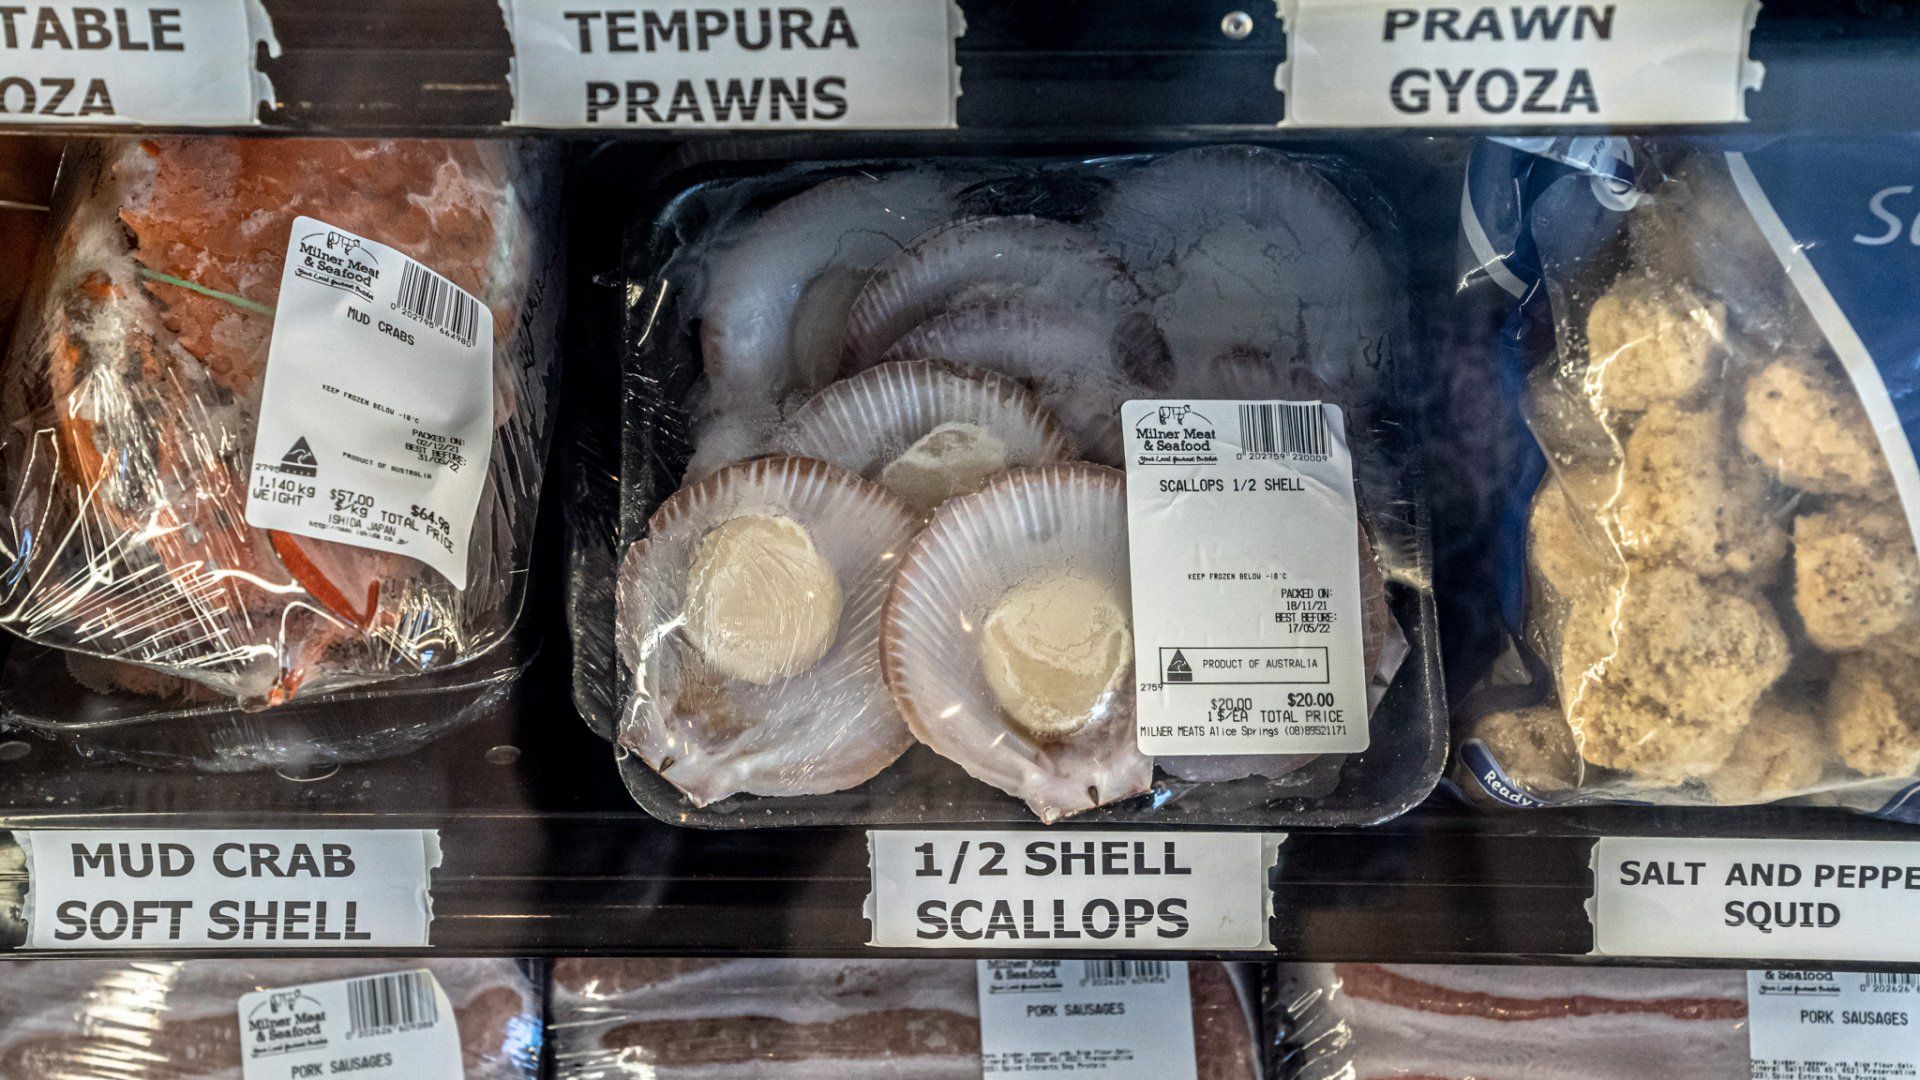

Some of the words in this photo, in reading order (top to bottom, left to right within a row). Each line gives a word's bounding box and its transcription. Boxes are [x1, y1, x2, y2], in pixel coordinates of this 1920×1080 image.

[0, 6, 185, 51] TABLE
[563, 7, 859, 54] TEMPURA
[1382, 4, 1616, 41] PRAWN
[585, 76, 849, 123] PRAWNS
[1389, 68, 1600, 114] GYOZA
[299, 242, 345, 266] Milner
[347, 259, 379, 279] Meat
[304, 256, 314, 268] &
[317, 260, 372, 287] Seafood
[347, 306, 371, 326] MUD
[378, 320, 415, 346] CRABS
[322, 384, 340, 394] KEEP
[343, 392, 369, 406] FROZEN
[373, 403, 395, 415] BELOW
[412, 428, 445, 443] PACKED
[1136, 428, 1180, 439] Milner
[1183, 428, 1216, 439] Meat
[405, 442, 427, 454] BEST
[432, 450, 467, 466] BEFORE:
[416, 438, 459, 453] 02/12/21
[1144, 440, 1154, 451] &
[1156, 440, 1211, 451] Seafood
[343, 452, 374, 465] PRODUCT
[378, 461, 387, 469] OF
[391, 466, 432, 479] AUSTRALIA
[1159, 479, 1224, 492] SCALLOPS
[1233, 478, 1257, 492] 1/2
[1264, 478, 1305, 491] SHELL
[253, 488, 303, 506] WEIGHT
[330, 488, 375, 508] $57.00
[411, 504, 450, 535] $64.98
[328, 514, 362, 528] ISHIDA
[367, 522, 396, 536] JAPAN
[381, 510, 419, 531] TOTAL
[426, 525, 454, 554] PRICE
[1188, 572, 1205, 580] KEEP
[1209, 572, 1235, 580] FROZEN
[1239, 572, 1261, 580] BELOW
[1281, 588, 1314, 598] PACKED
[1317, 588, 1333, 598] ON:
[1287, 600, 1327, 611] 18/11/21
[1275, 612, 1296, 623] BEST
[1301, 612, 1337, 623] BEFORE:
[1288, 623, 1331, 633] 17/05/22
[1203, 659, 1243, 669] PRODUCT
[1249, 659, 1260, 669] OF
[1266, 658, 1318, 669] AUSTRALIA
[1140, 683, 1163, 692] 2759
[1211, 698, 1253, 711] $20.00
[1287, 692, 1334, 707] $20.00
[1217, 709, 1249, 722] $/EA
[1260, 710, 1298, 722] TOTAL
[1306, 710, 1344, 722] PRICE
[1140, 726, 1173, 737] MILNER
[1177, 726, 1205, 736] MEATS
[1209, 726, 1237, 736] Alice
[1241, 726, 1279, 737] Springs
[1484, 769, 1533, 806] Ready
[71, 842, 195, 878] MUD
[212, 842, 356, 878] CRAB
[914, 840, 1008, 884] 1/2
[1024, 841, 1192, 877] SHELL
[1620, 860, 1706, 886] SALT
[1725, 863, 1802, 887] AND
[54, 900, 193, 941] SOFT
[207, 900, 371, 941] SHELL
[916, 898, 1190, 940] SCALLOPS
[1725, 901, 1841, 933] SQUID
[1027, 1005, 1058, 1017] PORK
[1064, 1002, 1125, 1017] SAUSAGES
[1801, 1010, 1834, 1024] PORK
[1842, 1010, 1909, 1026] SAUSAGES
[249, 1018, 290, 1031] Milner
[295, 1012, 326, 1024] Meat
[269, 1023, 321, 1040] Seafood
[291, 1063, 323, 1079] PORK
[330, 1053, 392, 1074] SAUSAGES
